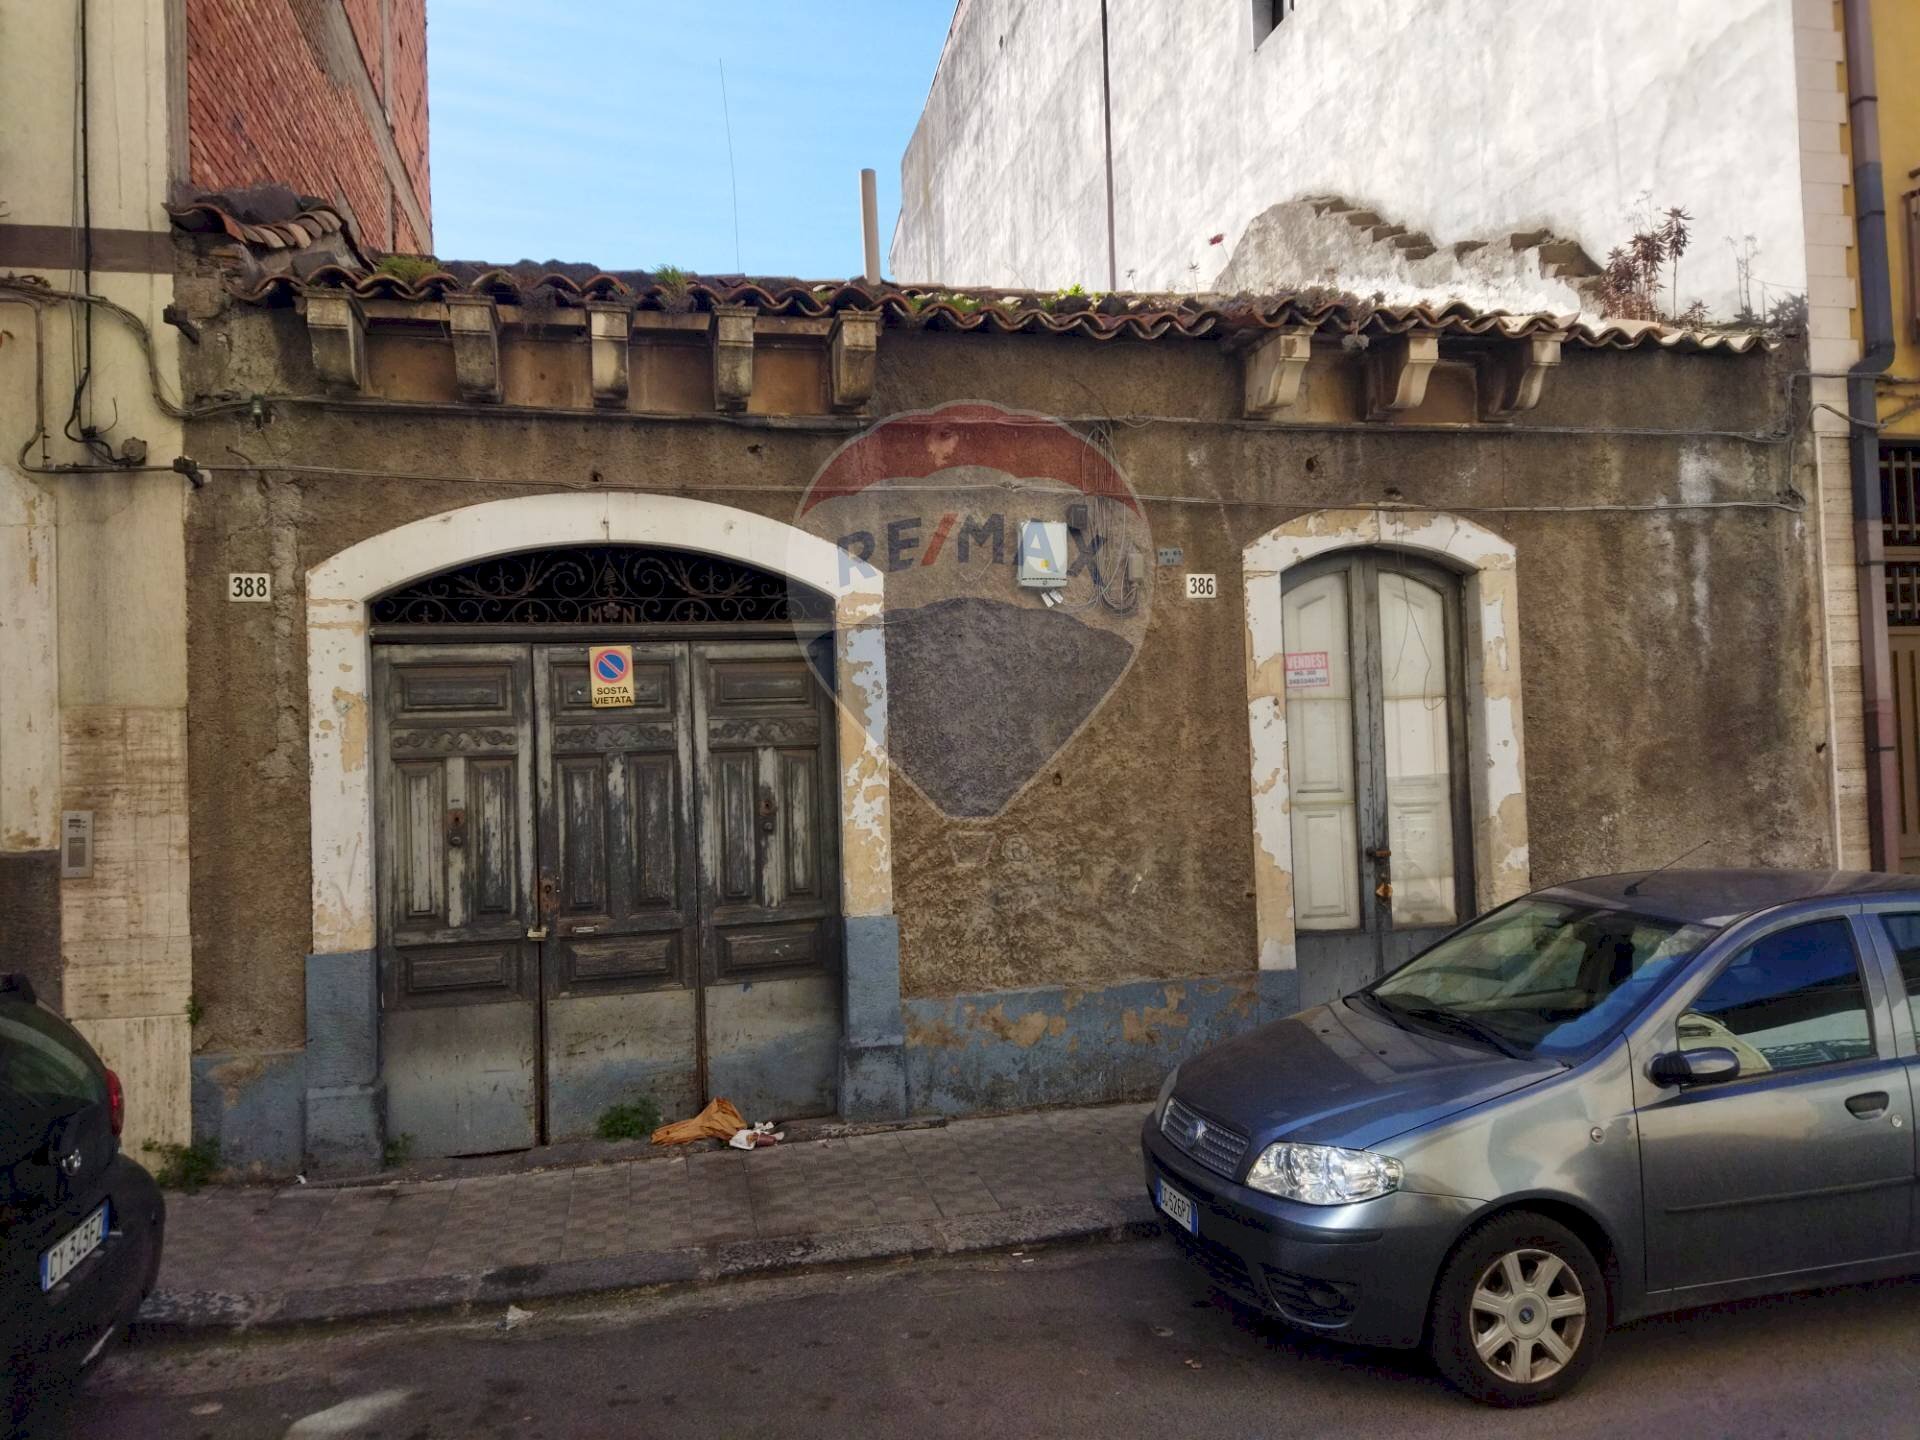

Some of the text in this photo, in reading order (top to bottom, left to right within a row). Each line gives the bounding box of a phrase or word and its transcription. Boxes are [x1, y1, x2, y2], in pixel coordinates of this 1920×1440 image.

[232, 576, 267, 598] 388
[1189, 577, 1214, 595] 386
[1287, 654, 1326, 669] VENDESI
[596, 686, 629, 695] SOSTA
[594, 695, 633, 705] VIETATA
